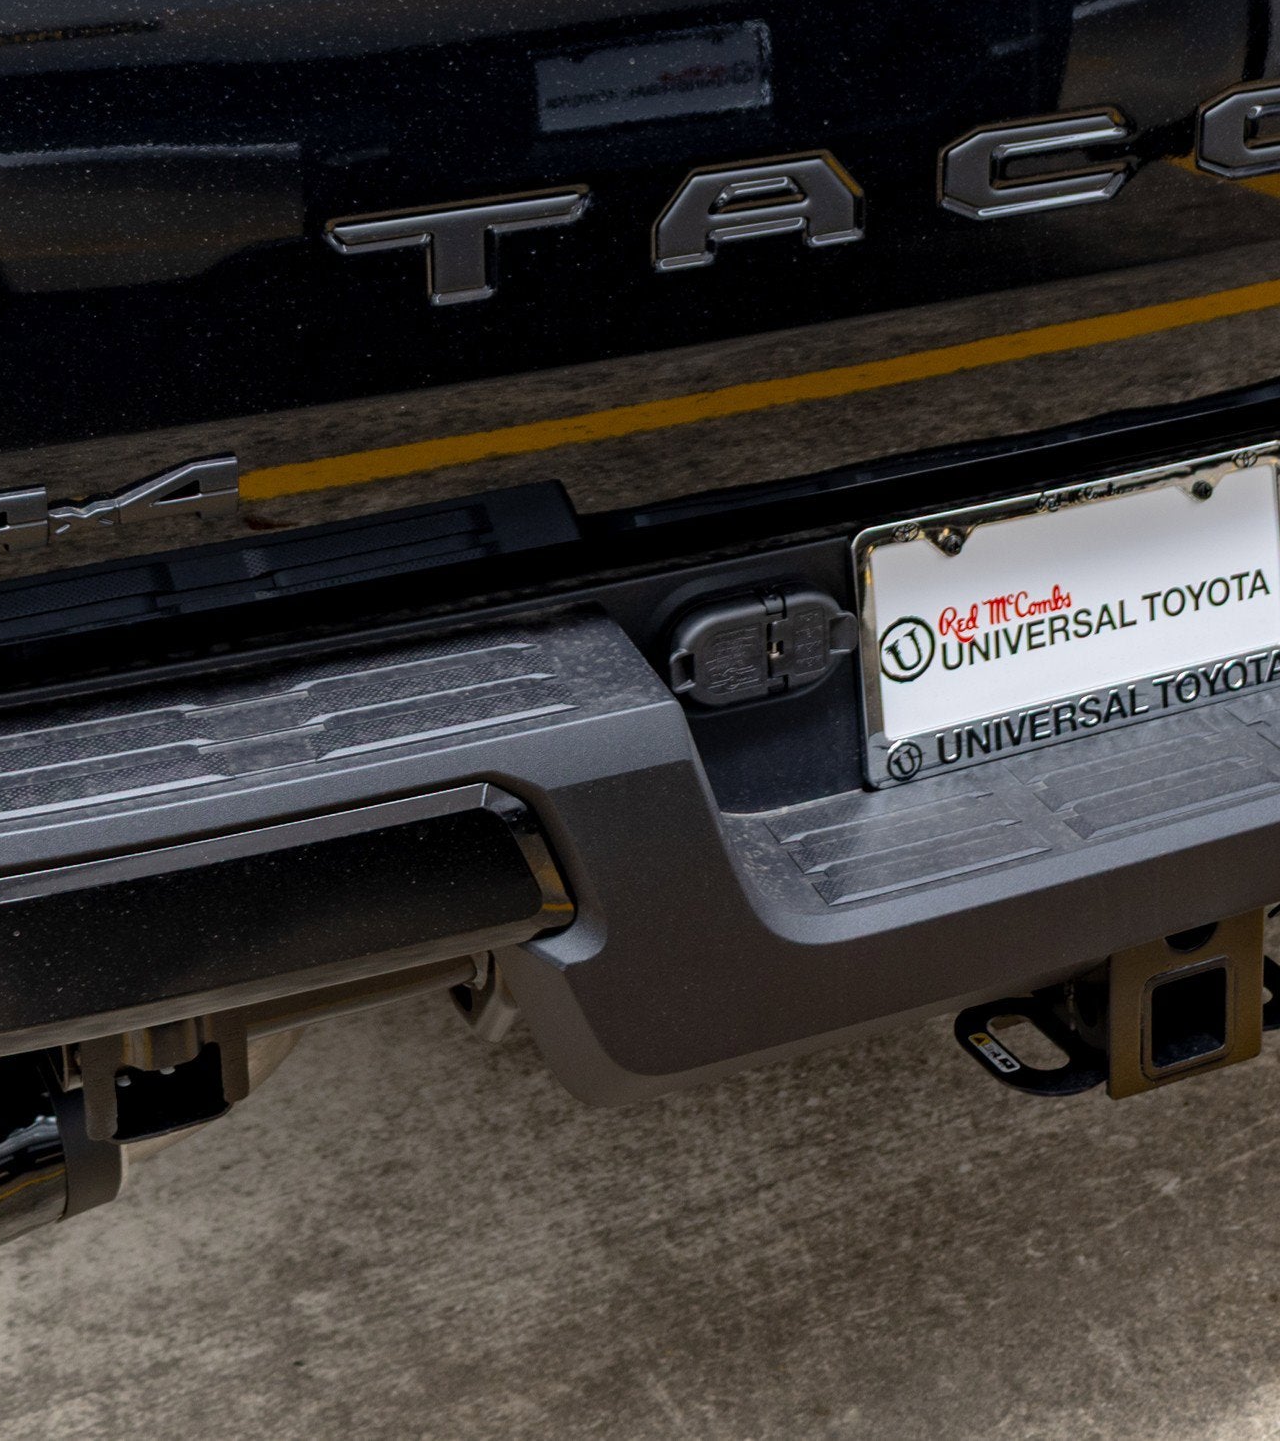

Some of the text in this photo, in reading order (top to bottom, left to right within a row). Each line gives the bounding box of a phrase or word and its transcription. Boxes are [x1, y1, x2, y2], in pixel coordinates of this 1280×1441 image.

[938, 584, 1072, 643] Red McCombs
[941, 600, 1137, 671] UNIVERSAL
[1141, 568, 1271, 622] TOYOTA
[936, 684, 1150, 765] UNIVERSAL
